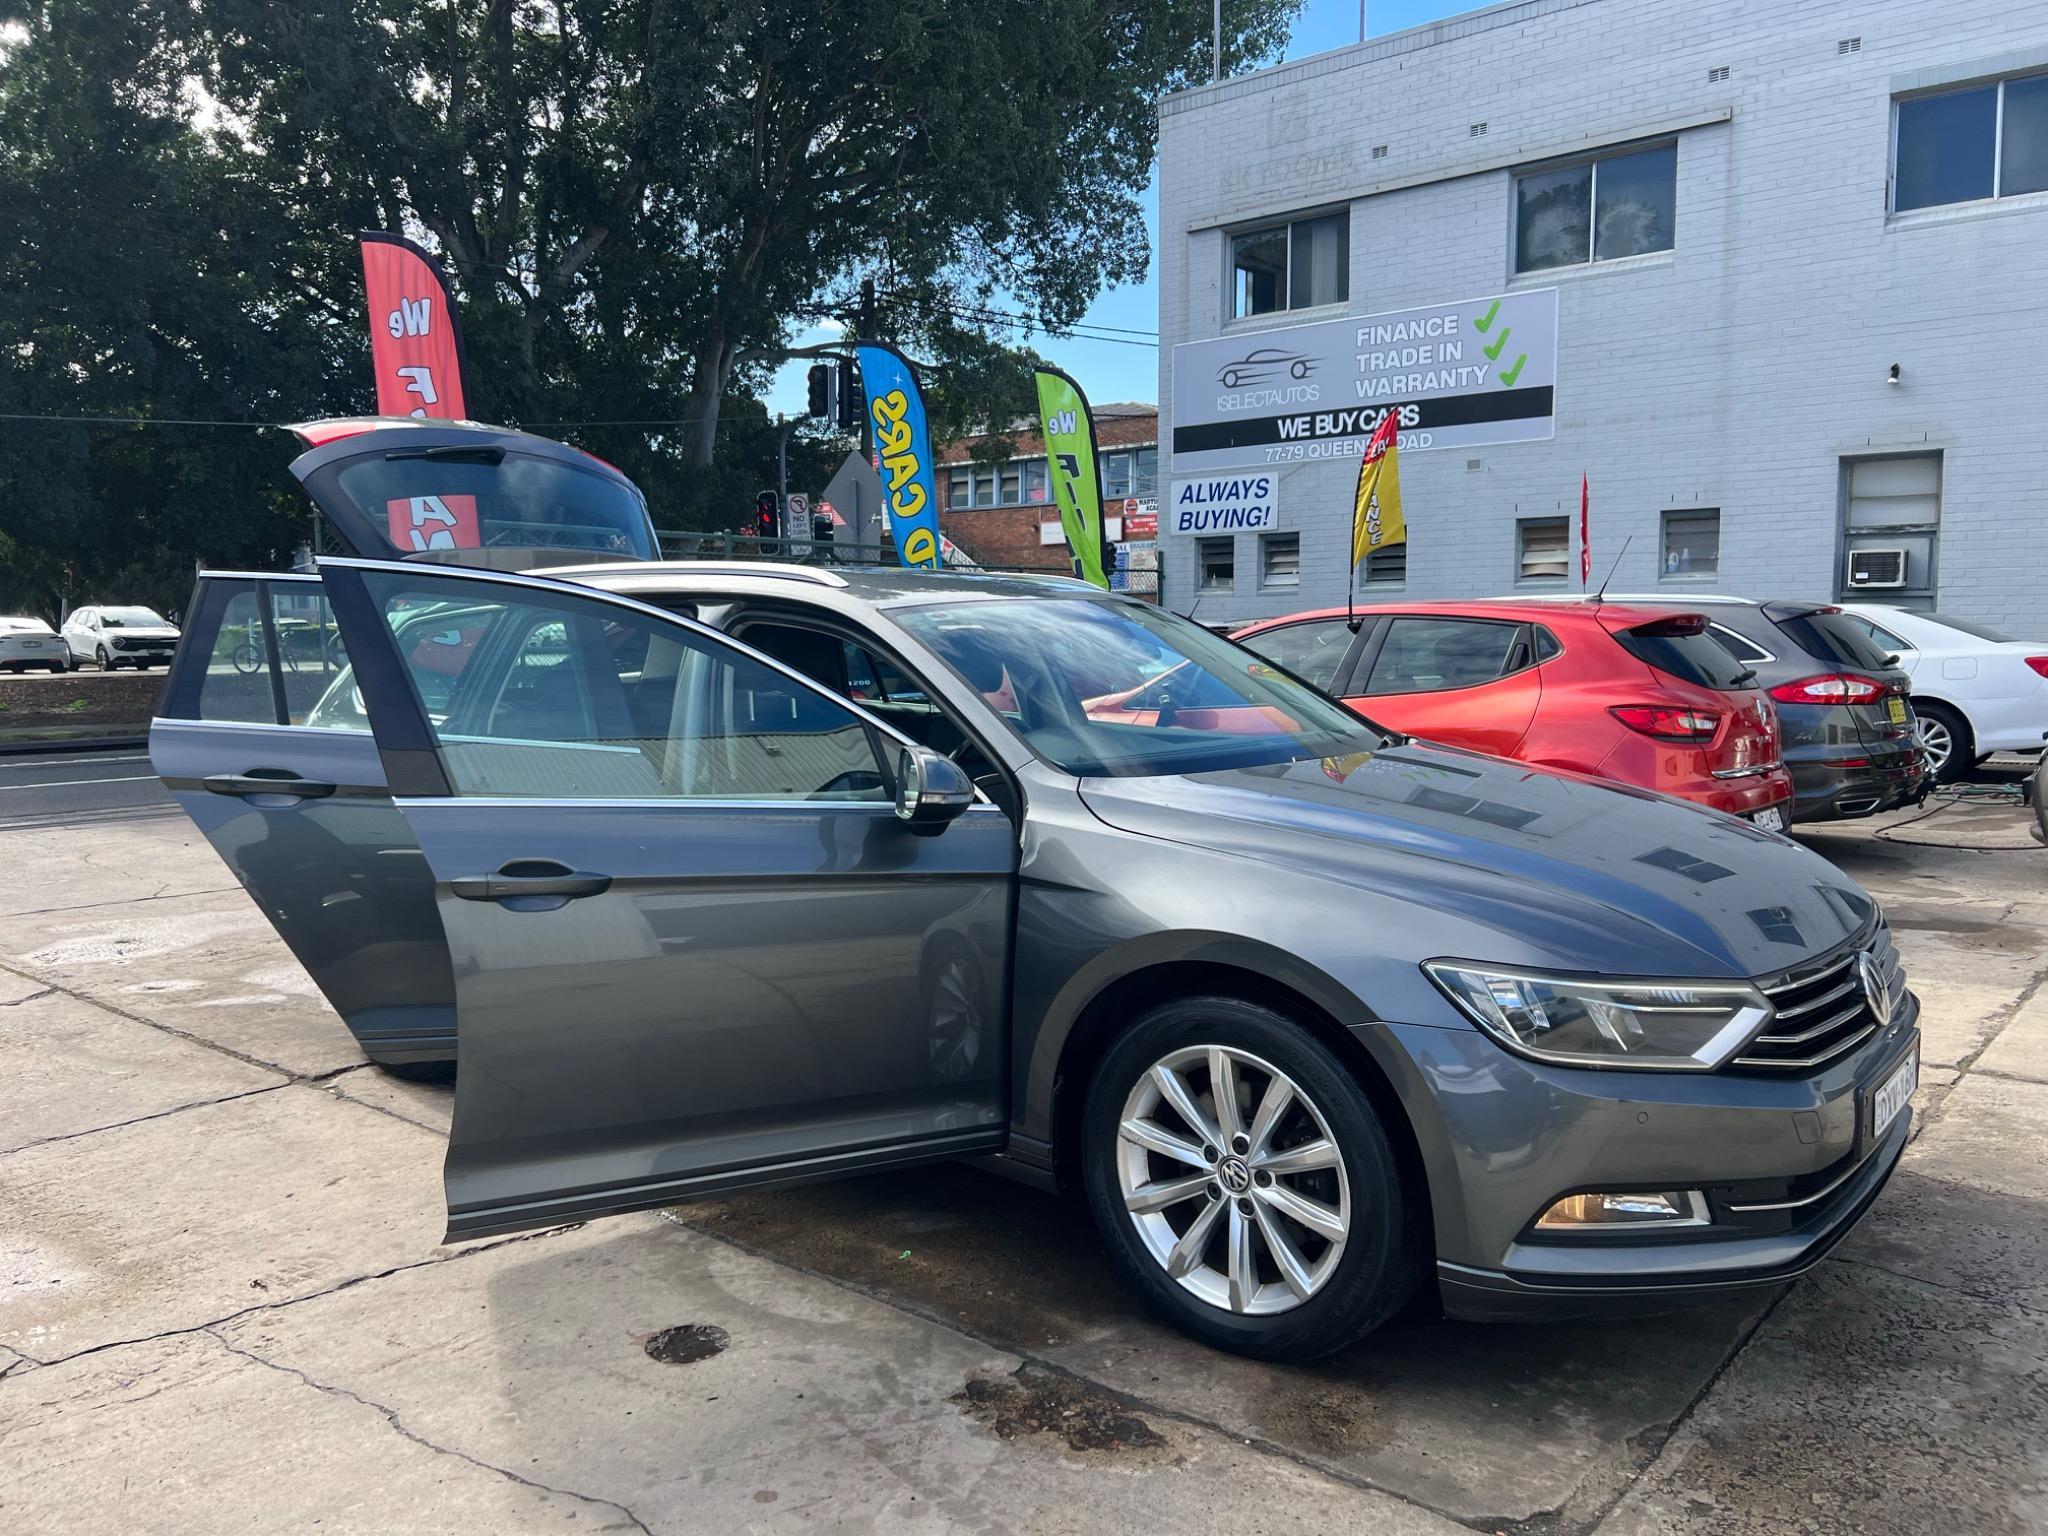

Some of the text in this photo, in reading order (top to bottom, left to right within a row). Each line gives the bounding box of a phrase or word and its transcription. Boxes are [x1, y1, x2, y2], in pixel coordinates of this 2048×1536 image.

[1356, 314, 1459, 348] FINANCE
[1355, 340, 1464, 373] TRADE IN
[1355, 364, 1490, 399] WARRANTY
[1217, 384, 1321, 412] ISELECTAUTOS
[1277, 415, 1313, 441] WE
[1314, 409, 1361, 436] BUY
[1265, 445, 1305, 463] 77-79
[1396, 432, 1433, 453] OAD
[1179, 478, 1270, 505] ALWAYS
[1178, 506, 1271, 532] BUYING!
